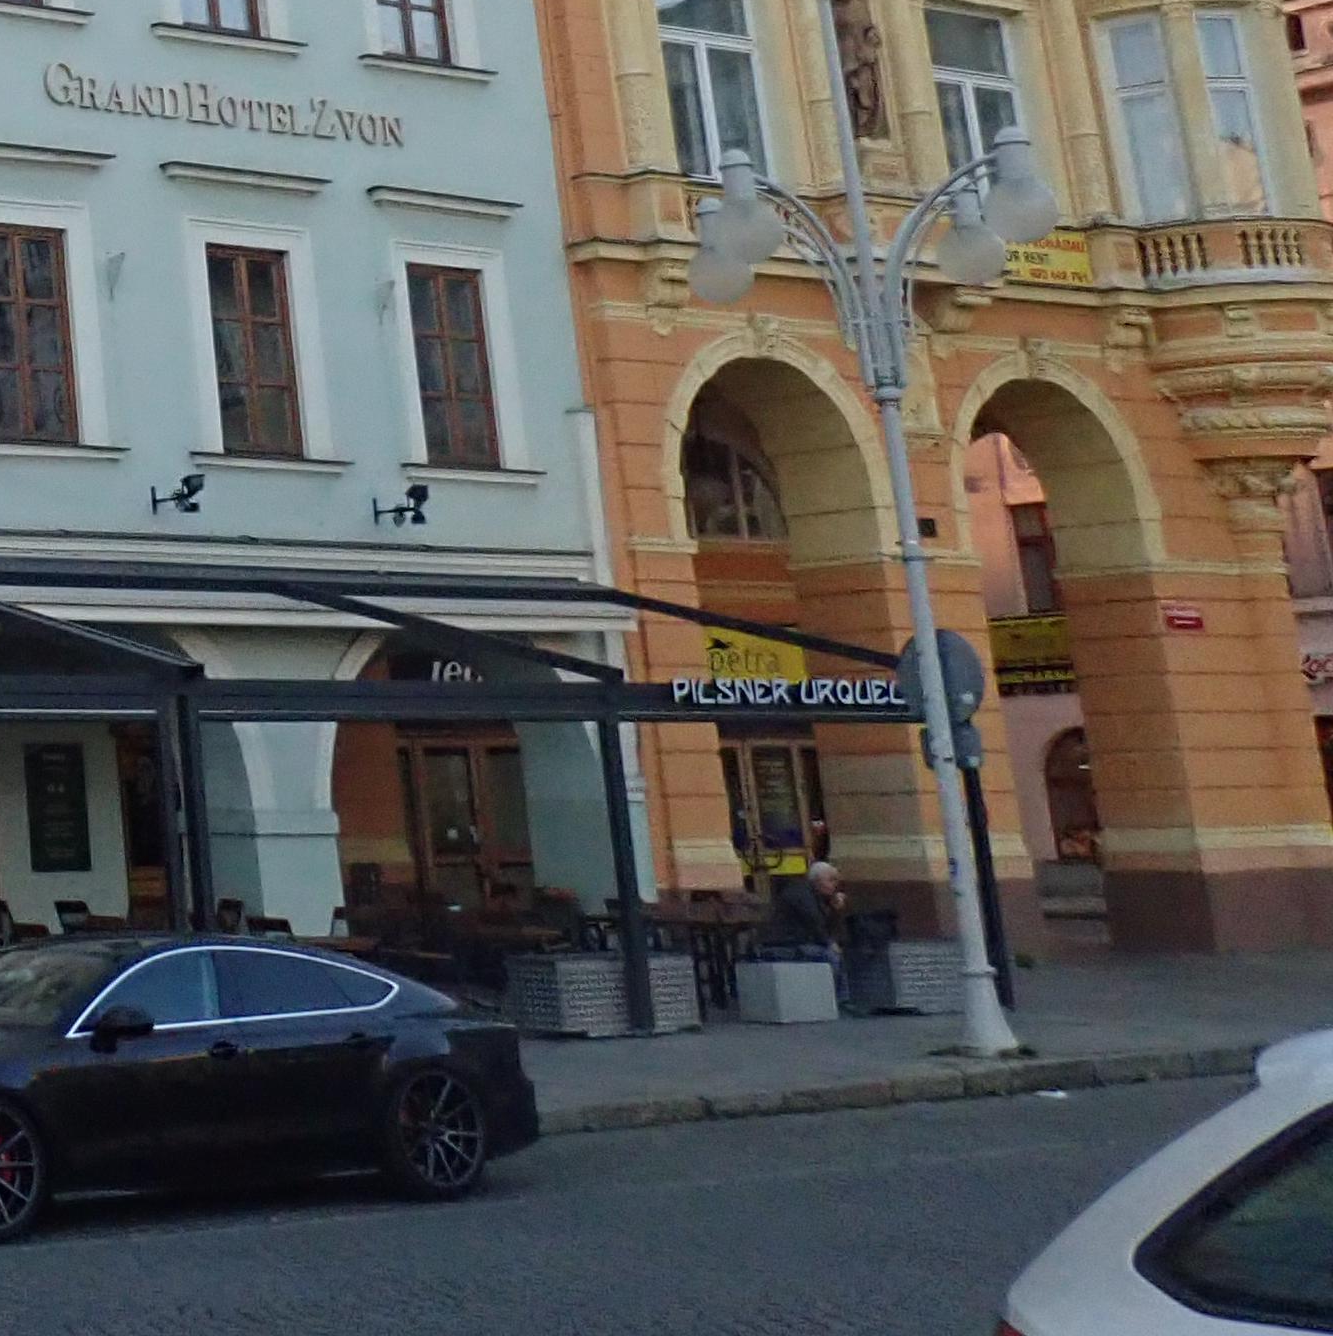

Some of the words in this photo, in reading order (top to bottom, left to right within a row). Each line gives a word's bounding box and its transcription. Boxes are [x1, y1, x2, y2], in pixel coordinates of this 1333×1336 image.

[43, 62, 182, 120] GRAND
[182, 80, 309, 137] HOTEL
[309, 96, 405, 148] ZVON
[672, 677, 789, 706] PILSNER
[800, 678, 906, 706] URQUEL
